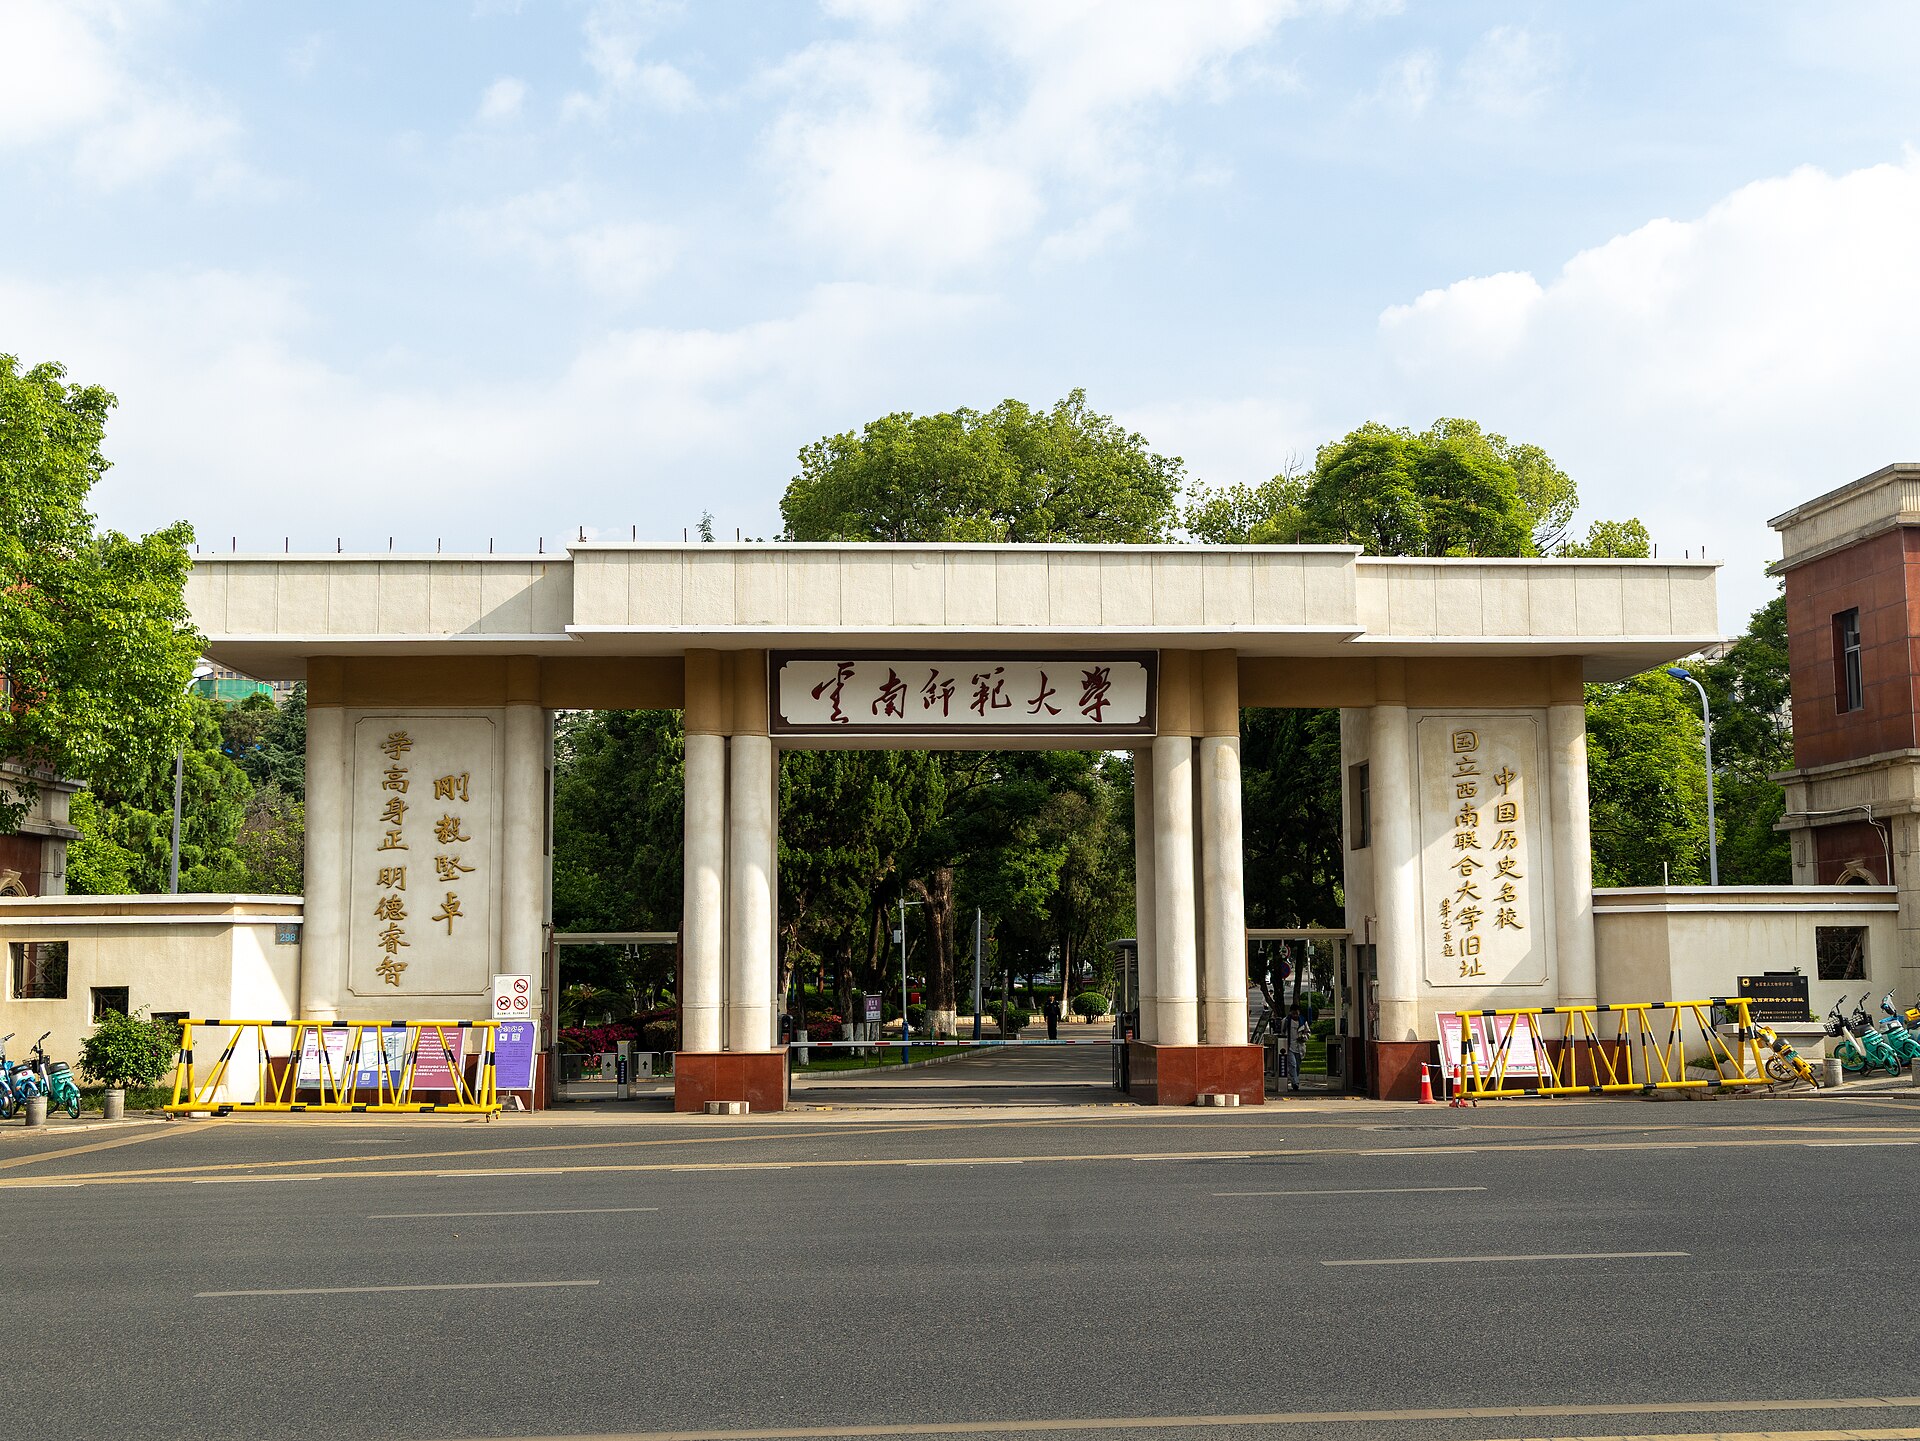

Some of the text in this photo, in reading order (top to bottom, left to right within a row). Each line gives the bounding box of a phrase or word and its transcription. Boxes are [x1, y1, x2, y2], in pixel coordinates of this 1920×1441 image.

[280, 933, 296, 942] 298
[374, 731, 413, 987] 学高身正明德睿智
[1450, 729, 1487, 978] 国立西南联合大学旧址
[1490, 766, 1524, 929] 中国历史名校
